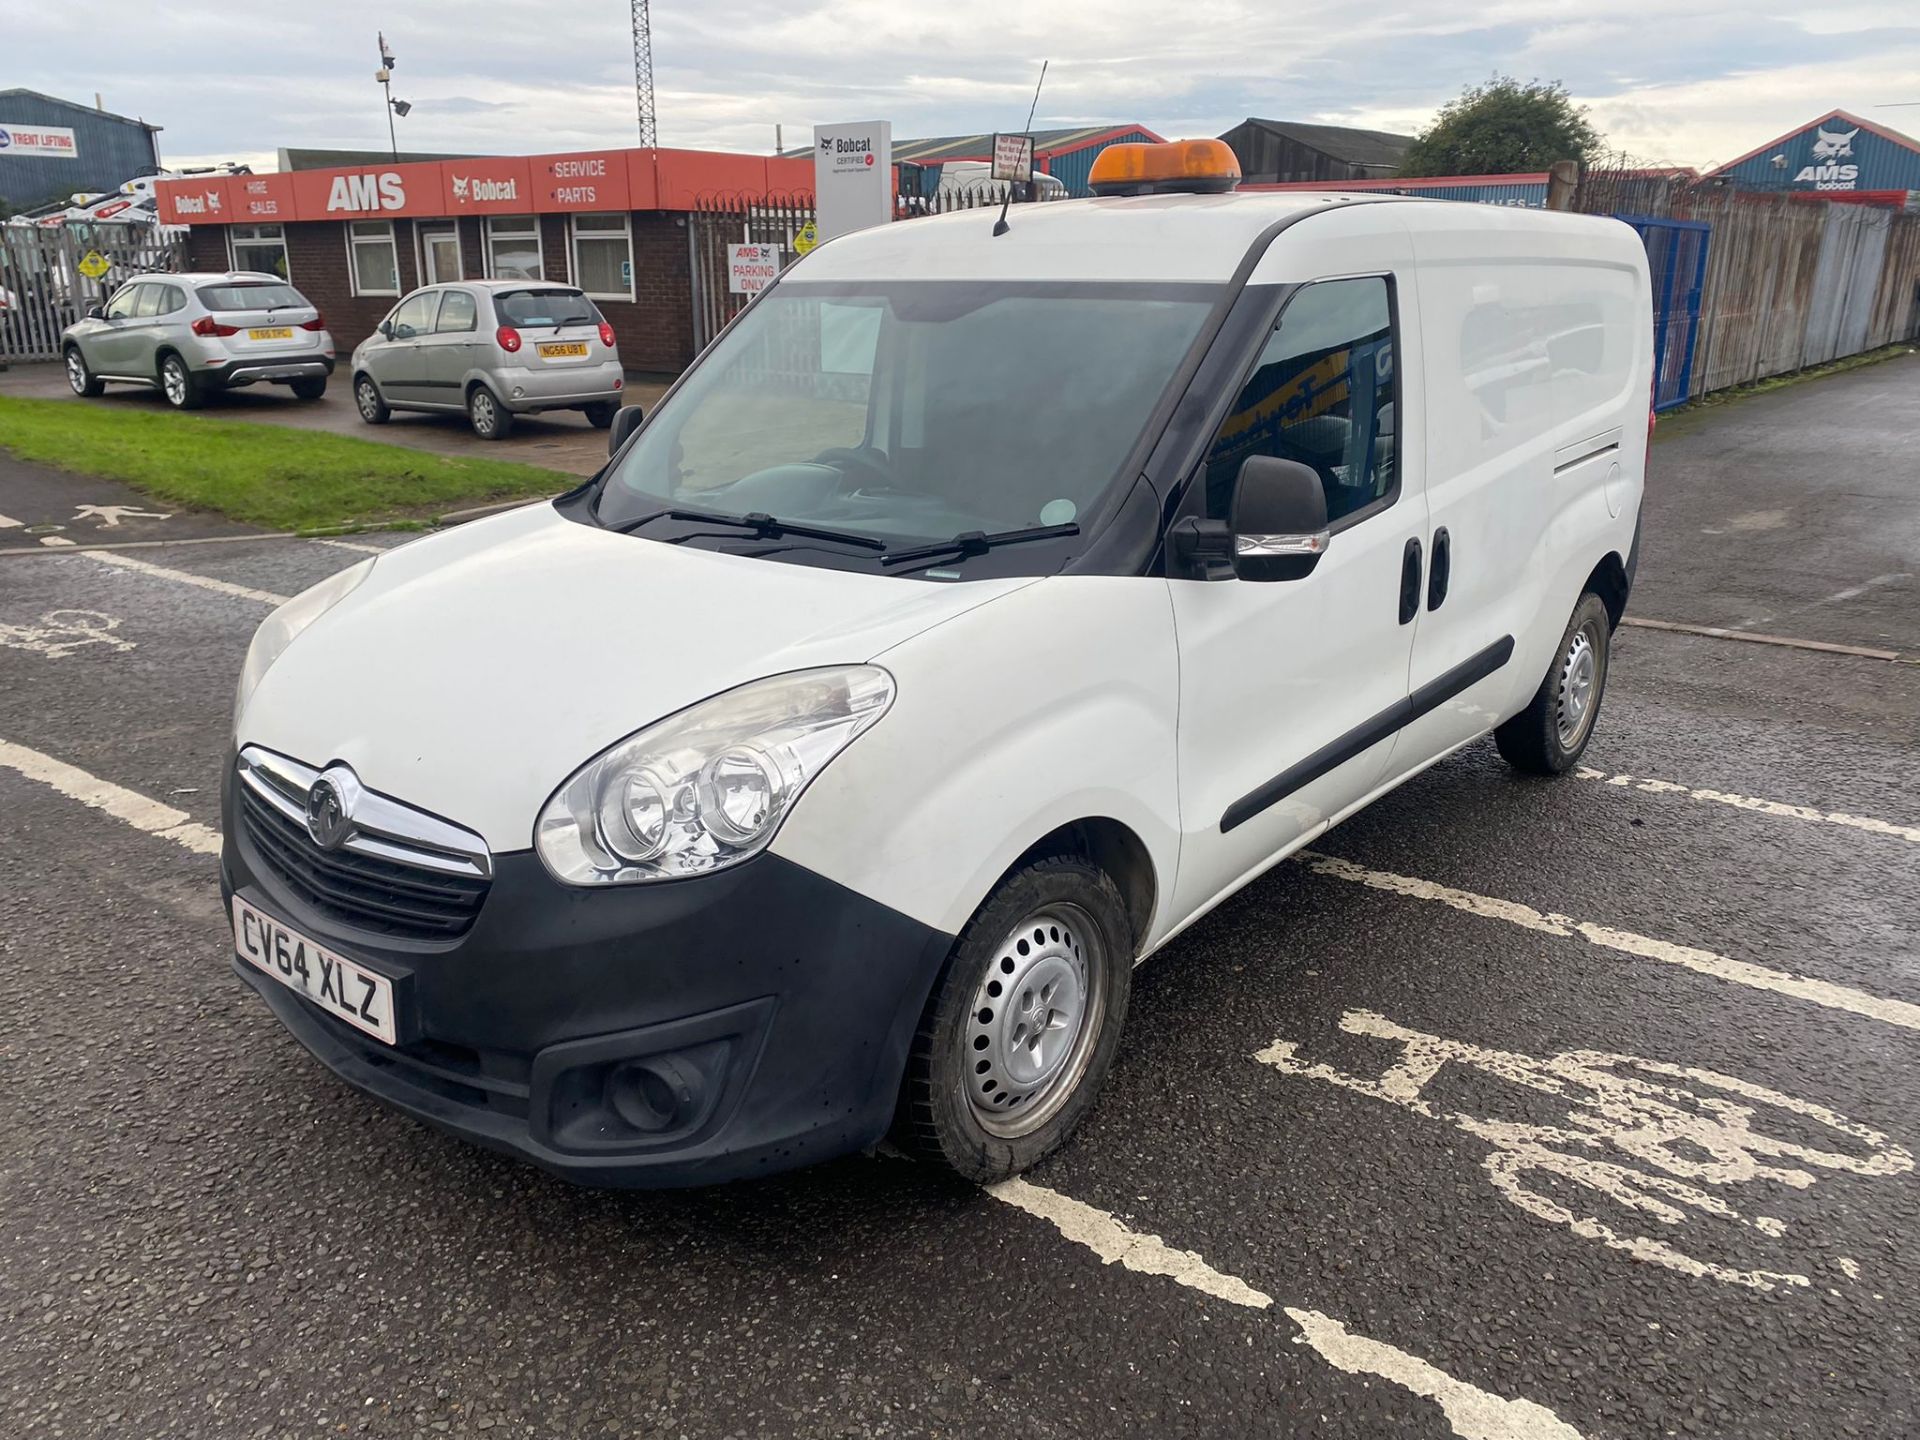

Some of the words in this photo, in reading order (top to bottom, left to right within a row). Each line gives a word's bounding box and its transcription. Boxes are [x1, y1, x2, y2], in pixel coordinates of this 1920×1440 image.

[12, 132, 39, 146] TRENT
[41, 134, 72, 148] LIFTING
[836, 136, 871, 153] Bobcat
[836, 155, 864, 165] CERTIFIED
[554, 159, 606, 178] SERVICE
[1793, 164, 1858, 181] AMS
[247, 181, 268, 194] HIRE
[326, 172, 406, 211] AMS
[472, 177, 517, 201] Bobcat
[1816, 180, 1856, 191] bobcat
[557, 186, 596, 203] PARTS
[174, 195, 207, 214] Bobcat
[250, 200, 278, 214] SALES
[736, 247, 759, 258] AMS
[733, 265, 774, 278] PARKING
[741, 279, 765, 291] ONLY
[567, 344, 582, 354] UBT
[242, 908, 310, 988] CV64
[317, 950, 379, 1028] XLZ
